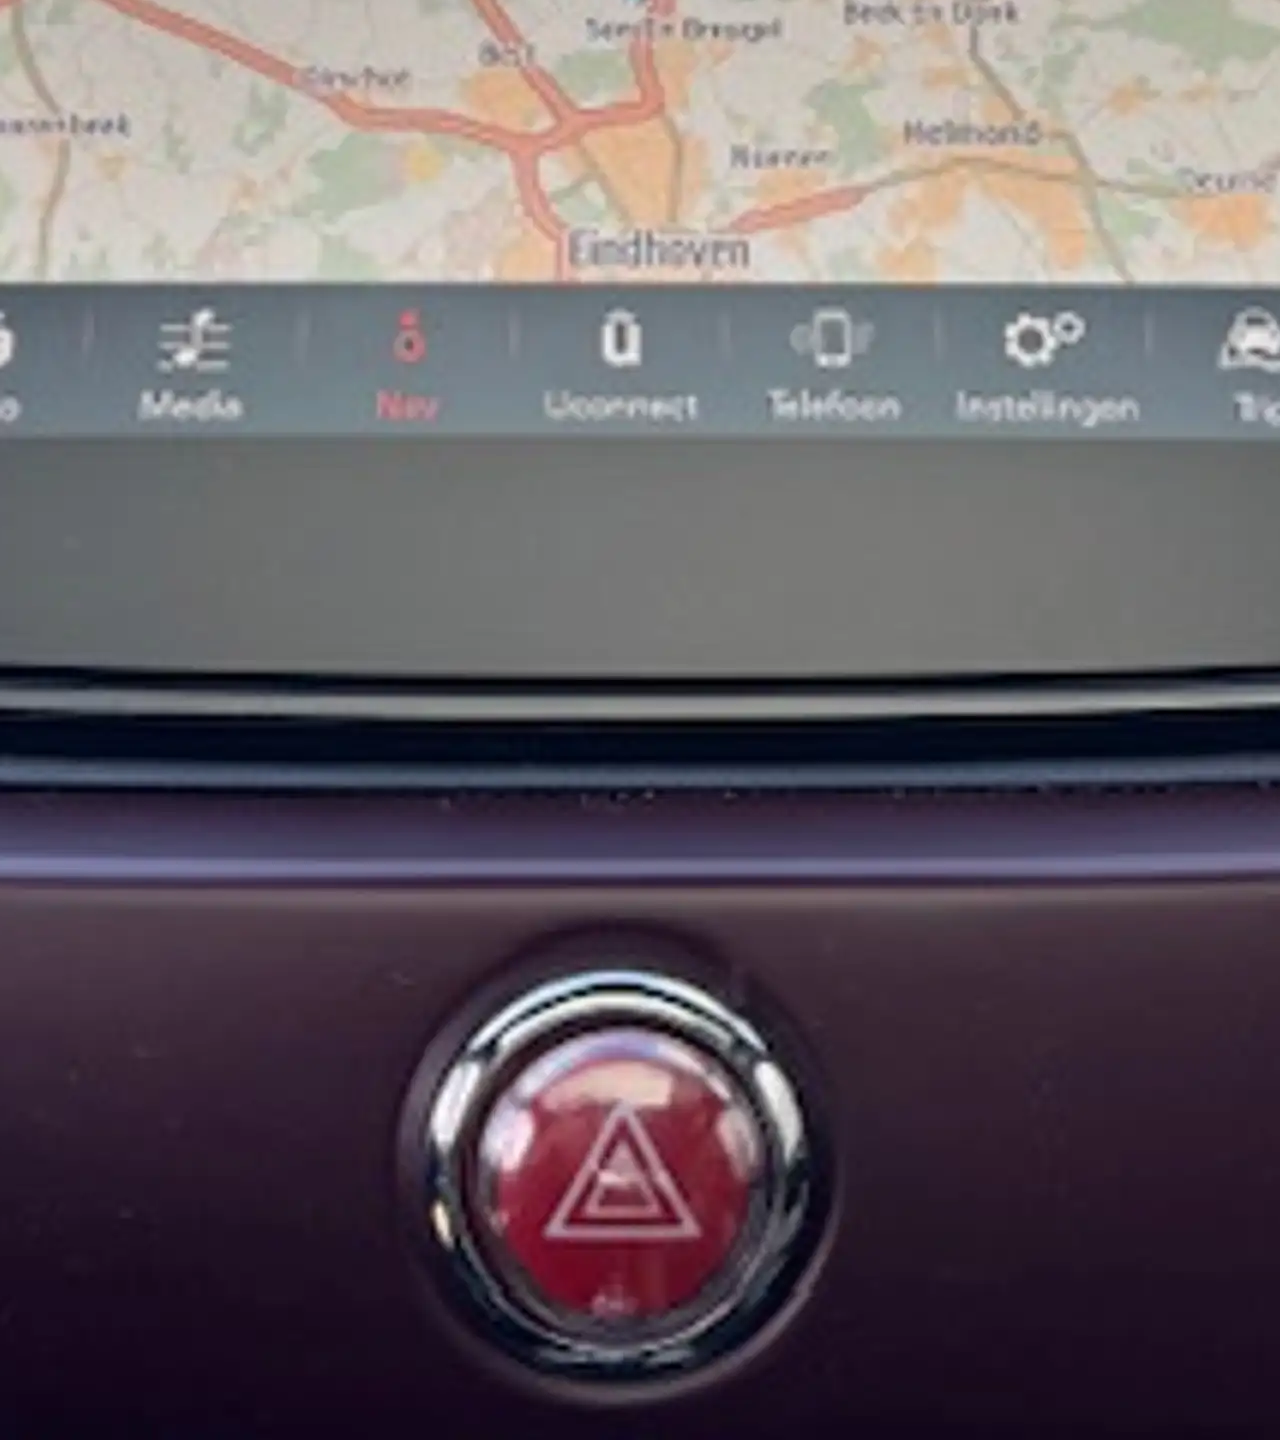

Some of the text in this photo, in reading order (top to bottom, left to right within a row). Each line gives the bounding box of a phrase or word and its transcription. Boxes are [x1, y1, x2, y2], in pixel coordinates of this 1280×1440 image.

[569, 228, 750, 268] Eindhoven
[137, 388, 244, 422] Media
[376, 389, 440, 422] Nav
[543, 389, 698, 422] Uconnect
[766, 388, 902, 422] Telefoon
[956, 390, 1140, 428] Instellingen
